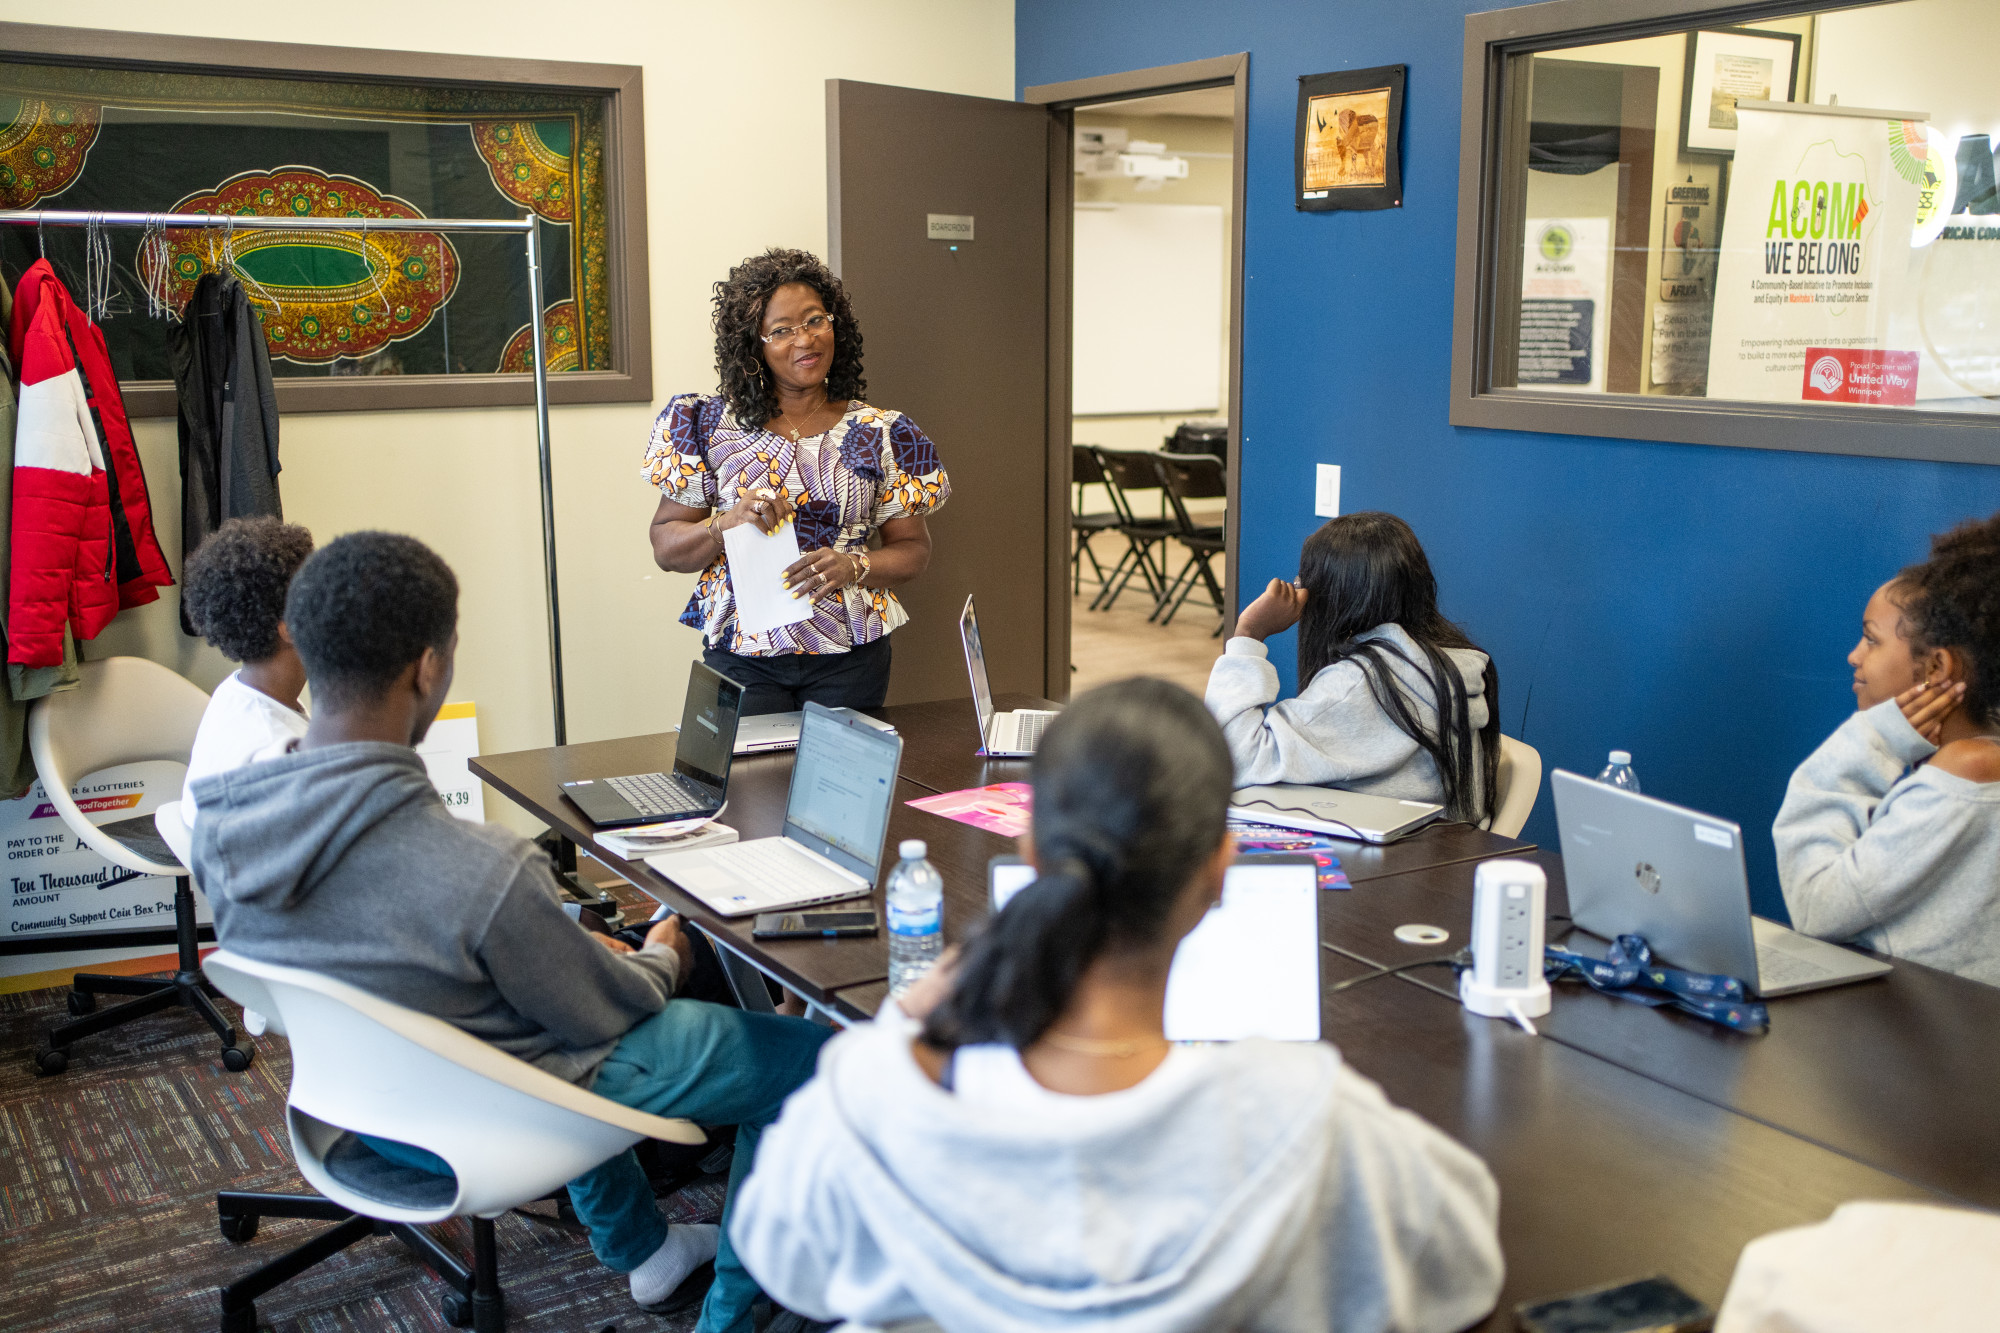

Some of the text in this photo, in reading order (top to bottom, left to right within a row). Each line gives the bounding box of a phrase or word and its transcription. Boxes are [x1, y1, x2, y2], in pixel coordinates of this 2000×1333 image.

[1766, 179, 1866, 240] ACOMI
[1935, 226, 1976, 240] RICAN
[1765, 241, 1860, 275] WE BELONG
[1756, 280, 1803, 292] Community-Based
[1832, 280, 1853, 290] Promote
[1754, 294, 1765, 304] and
[1766, 293, 1783, 305] Equity
[1815, 293, 1825, 303] Arts
[1826, 293, 1836, 303] and
[1837, 293, 1855, 303] Culture
[1855, 293, 1869, 303] Sector
[1741, 338, 1782, 349] Empowering
[1747, 351, 1765, 360] build
[1850, 361, 1870, 369] Proud
[1871, 362, 1895, 370] Partner
[1849, 373, 1909, 389] United Way
[1848, 387, 1882, 397] Winnipeg
[82, 785, 91, 794] &
[93, 780, 145, 793] LOTTERIES
[7, 834, 65, 849] PAY TO THE
[8, 846, 60, 860] ORDER OF
[11, 877, 36, 894] Ten
[40, 866, 108, 891] Thousand
[12, 893, 60, 907] AMOUNT
[11, 916, 67, 933] Community
[69, 909, 108, 927] Support
[109, 907, 131, 919] Coin
[133, 904, 154, 916] Box
